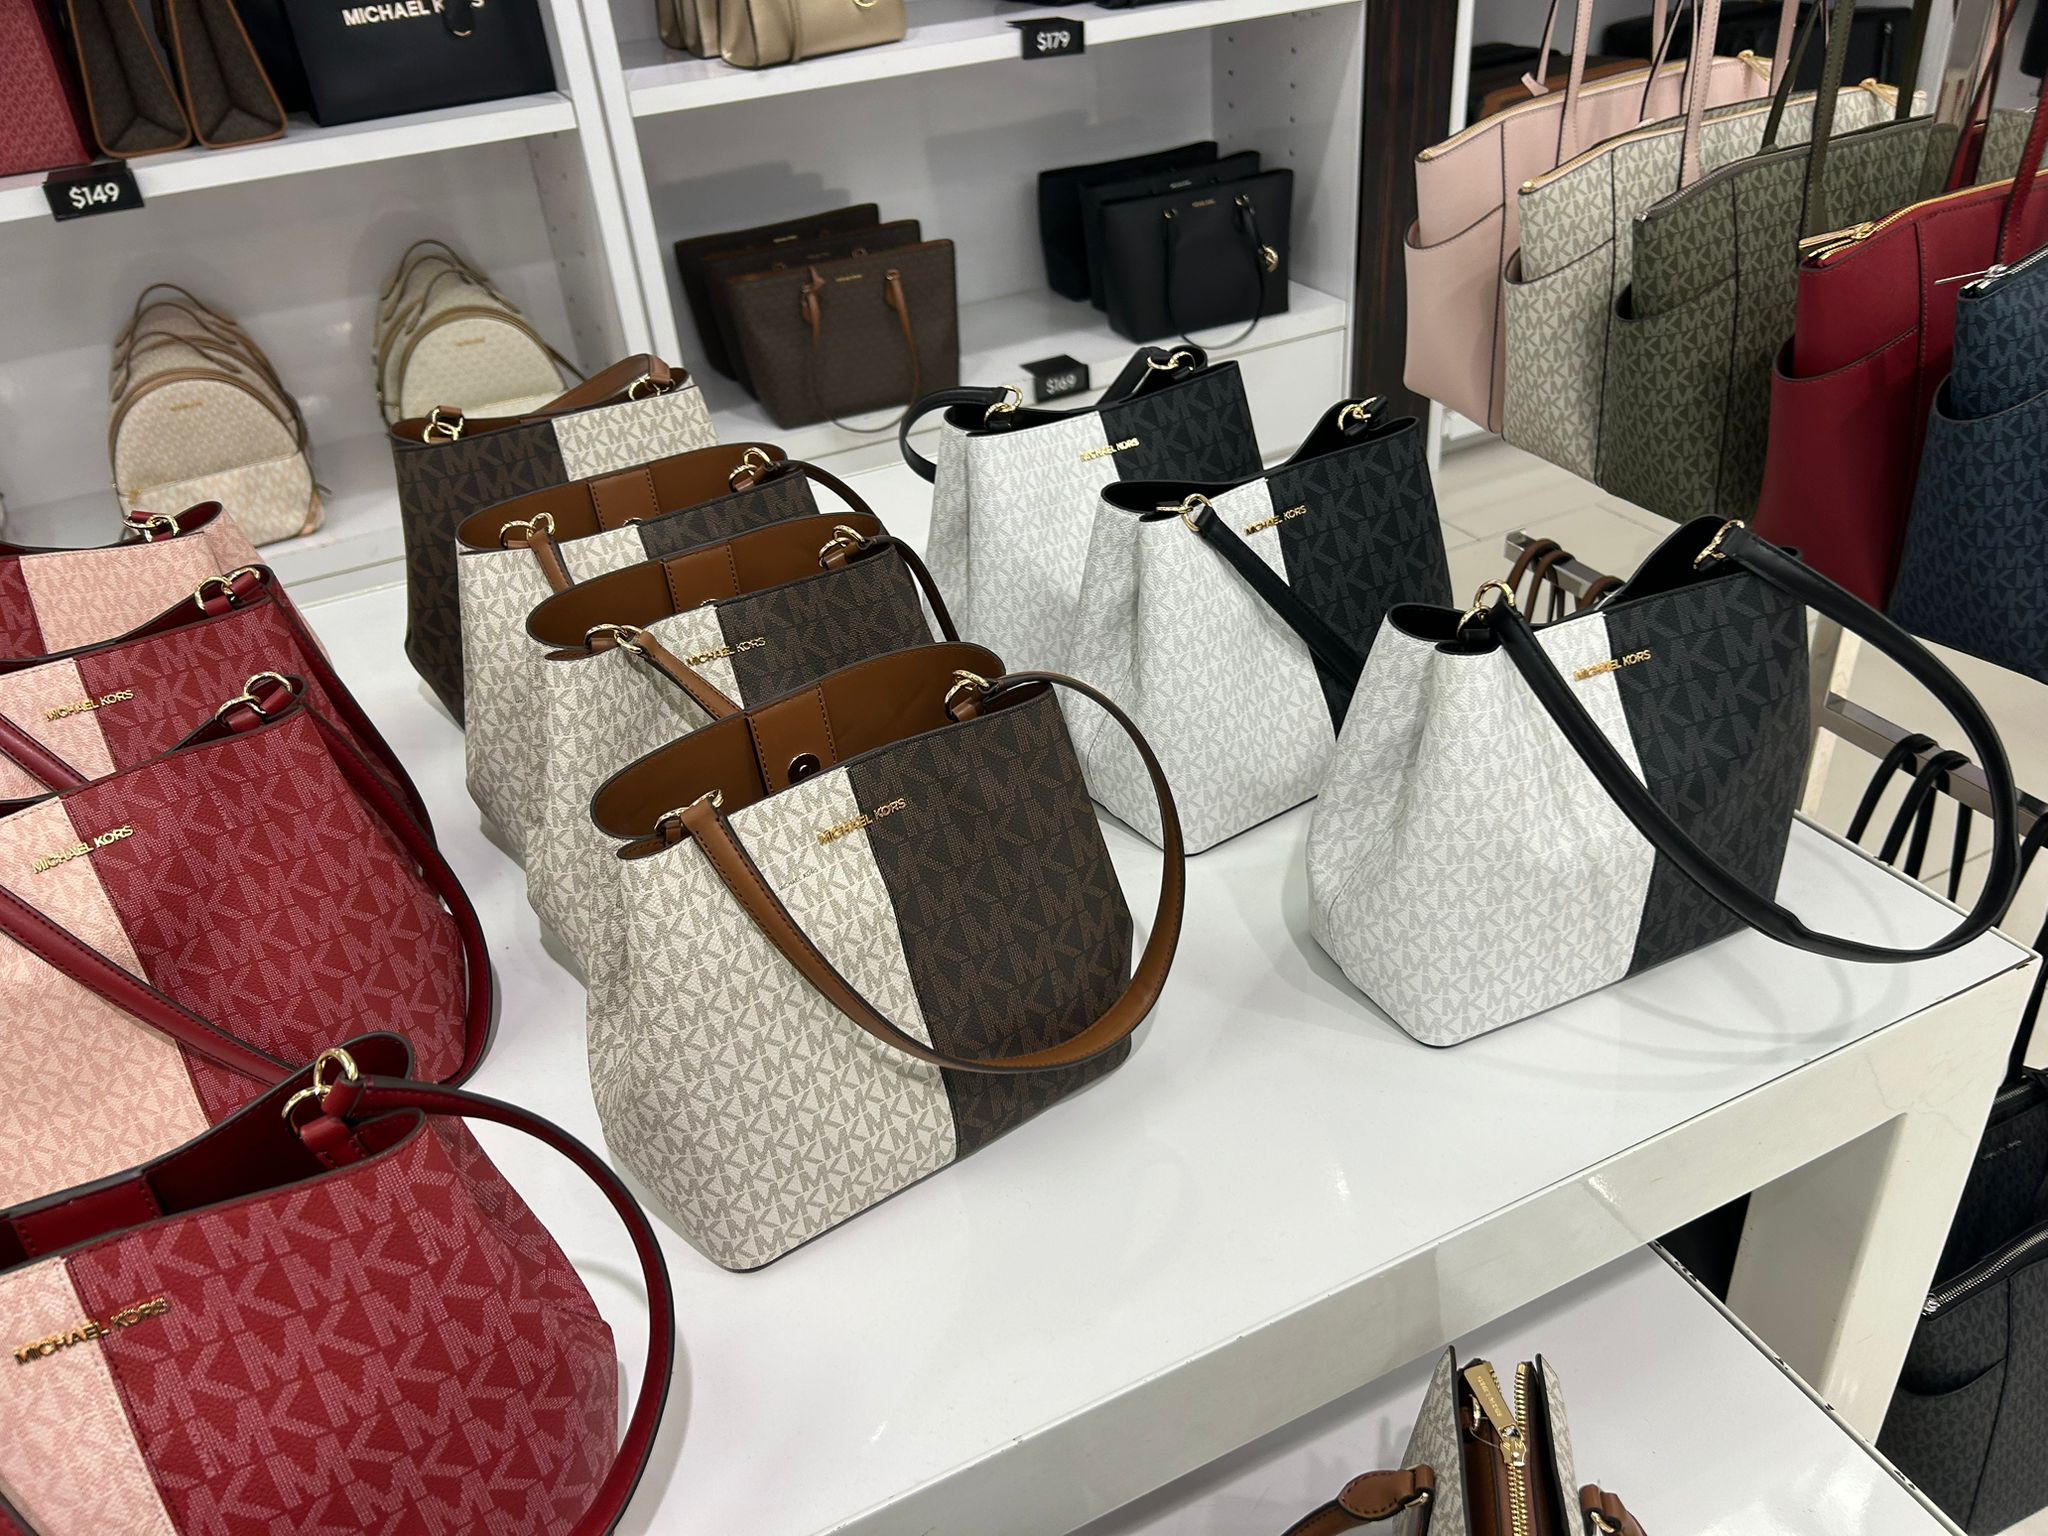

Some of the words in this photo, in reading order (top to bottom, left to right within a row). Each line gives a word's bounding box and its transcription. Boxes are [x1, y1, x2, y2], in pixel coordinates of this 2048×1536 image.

[341, 1, 430, 26] MICHAEL
[1036, 30, 1071, 52] $179
[69, 182, 120, 210] $149
[1282, 504, 1307, 520] KORS
[735, 637, 766, 653] KORS
[1621, 649, 1652, 667] KORS
[44, 699, 100, 722] MICHAEL
[99, 689, 134, 706] KORS
[816, 814, 873, 845] MICHAEL
[872, 797, 907, 820] KORS
[31, 842, 94, 874] MICHAEL
[93, 825, 134, 847] KORS
[13, 1320, 111, 1365] MICHAEL
[109, 1296, 170, 1329] KORS
